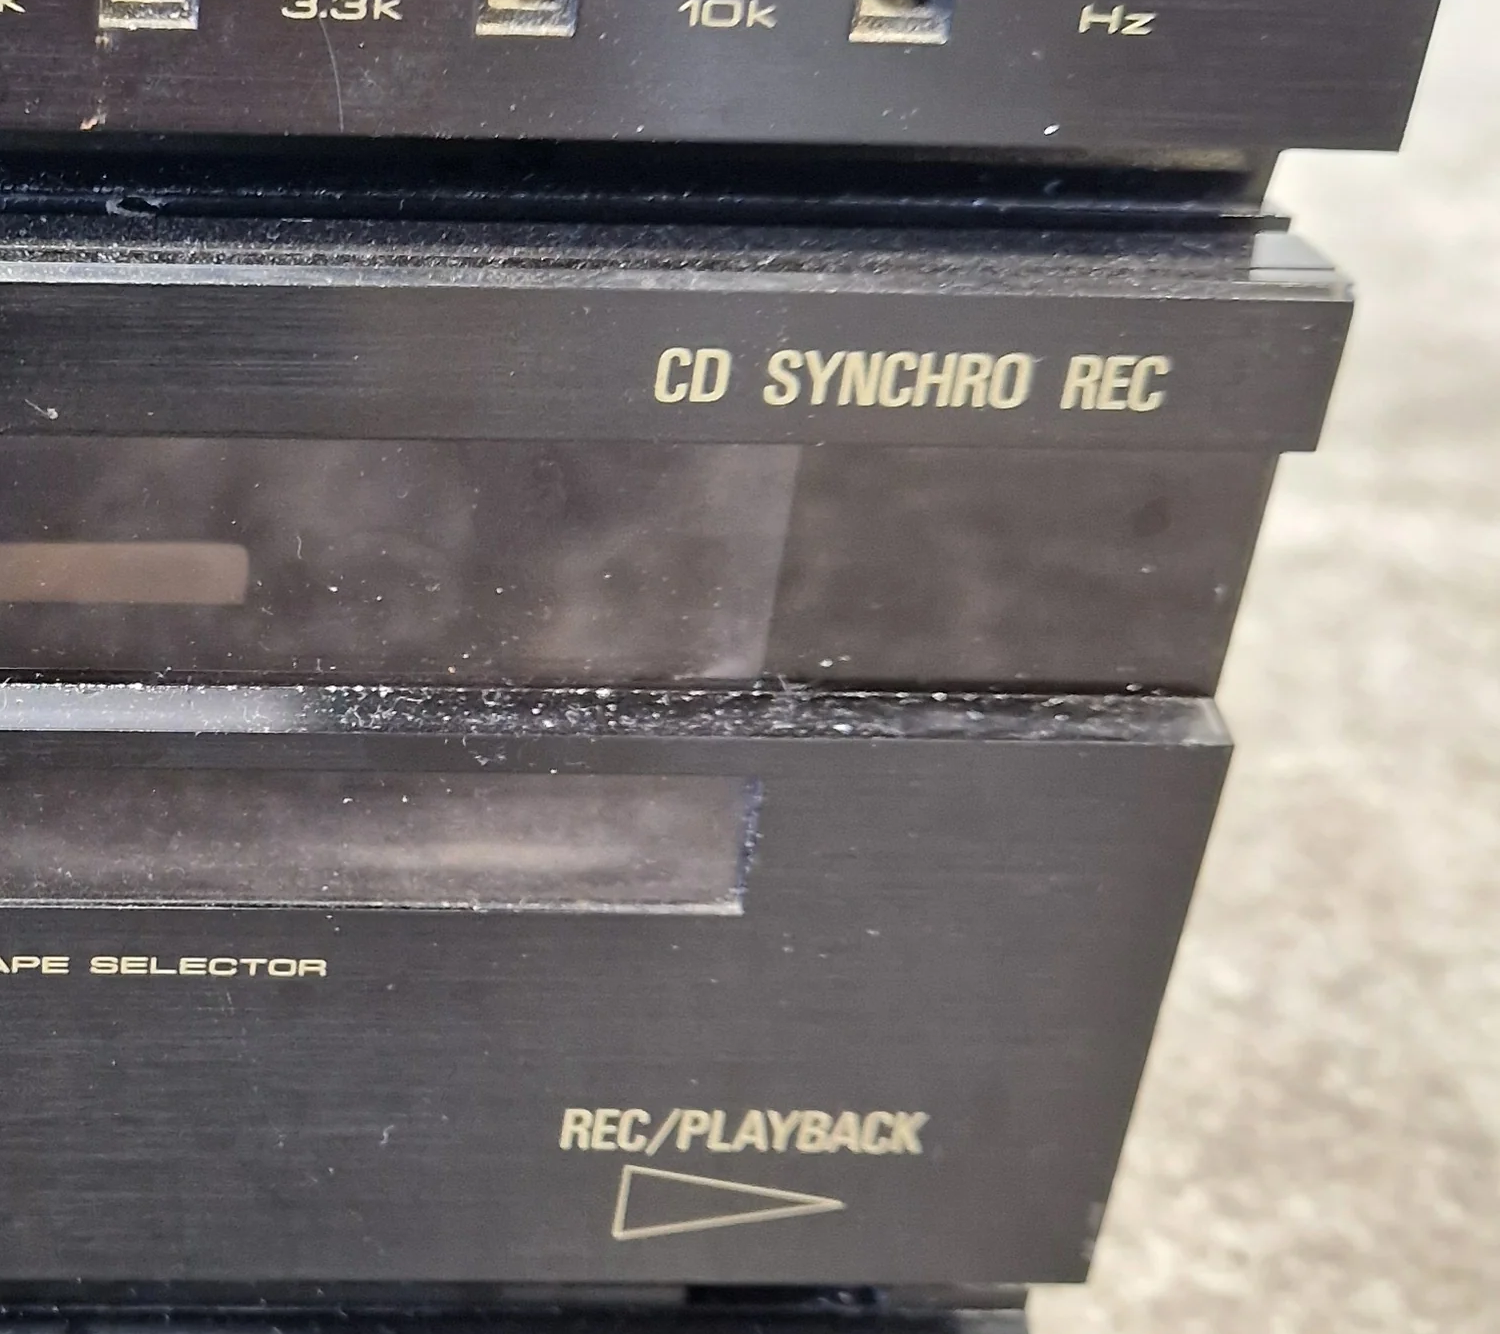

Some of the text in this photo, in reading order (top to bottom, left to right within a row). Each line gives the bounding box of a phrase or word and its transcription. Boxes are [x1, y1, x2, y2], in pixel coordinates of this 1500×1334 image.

[1078, 4, 1156, 35] Hz
[654, 347, 1170, 412] CD SYNCHRO REC
[89, 956, 327, 977] SELECTOR
[559, 1108, 928, 1156] REC/PLAYBACK
